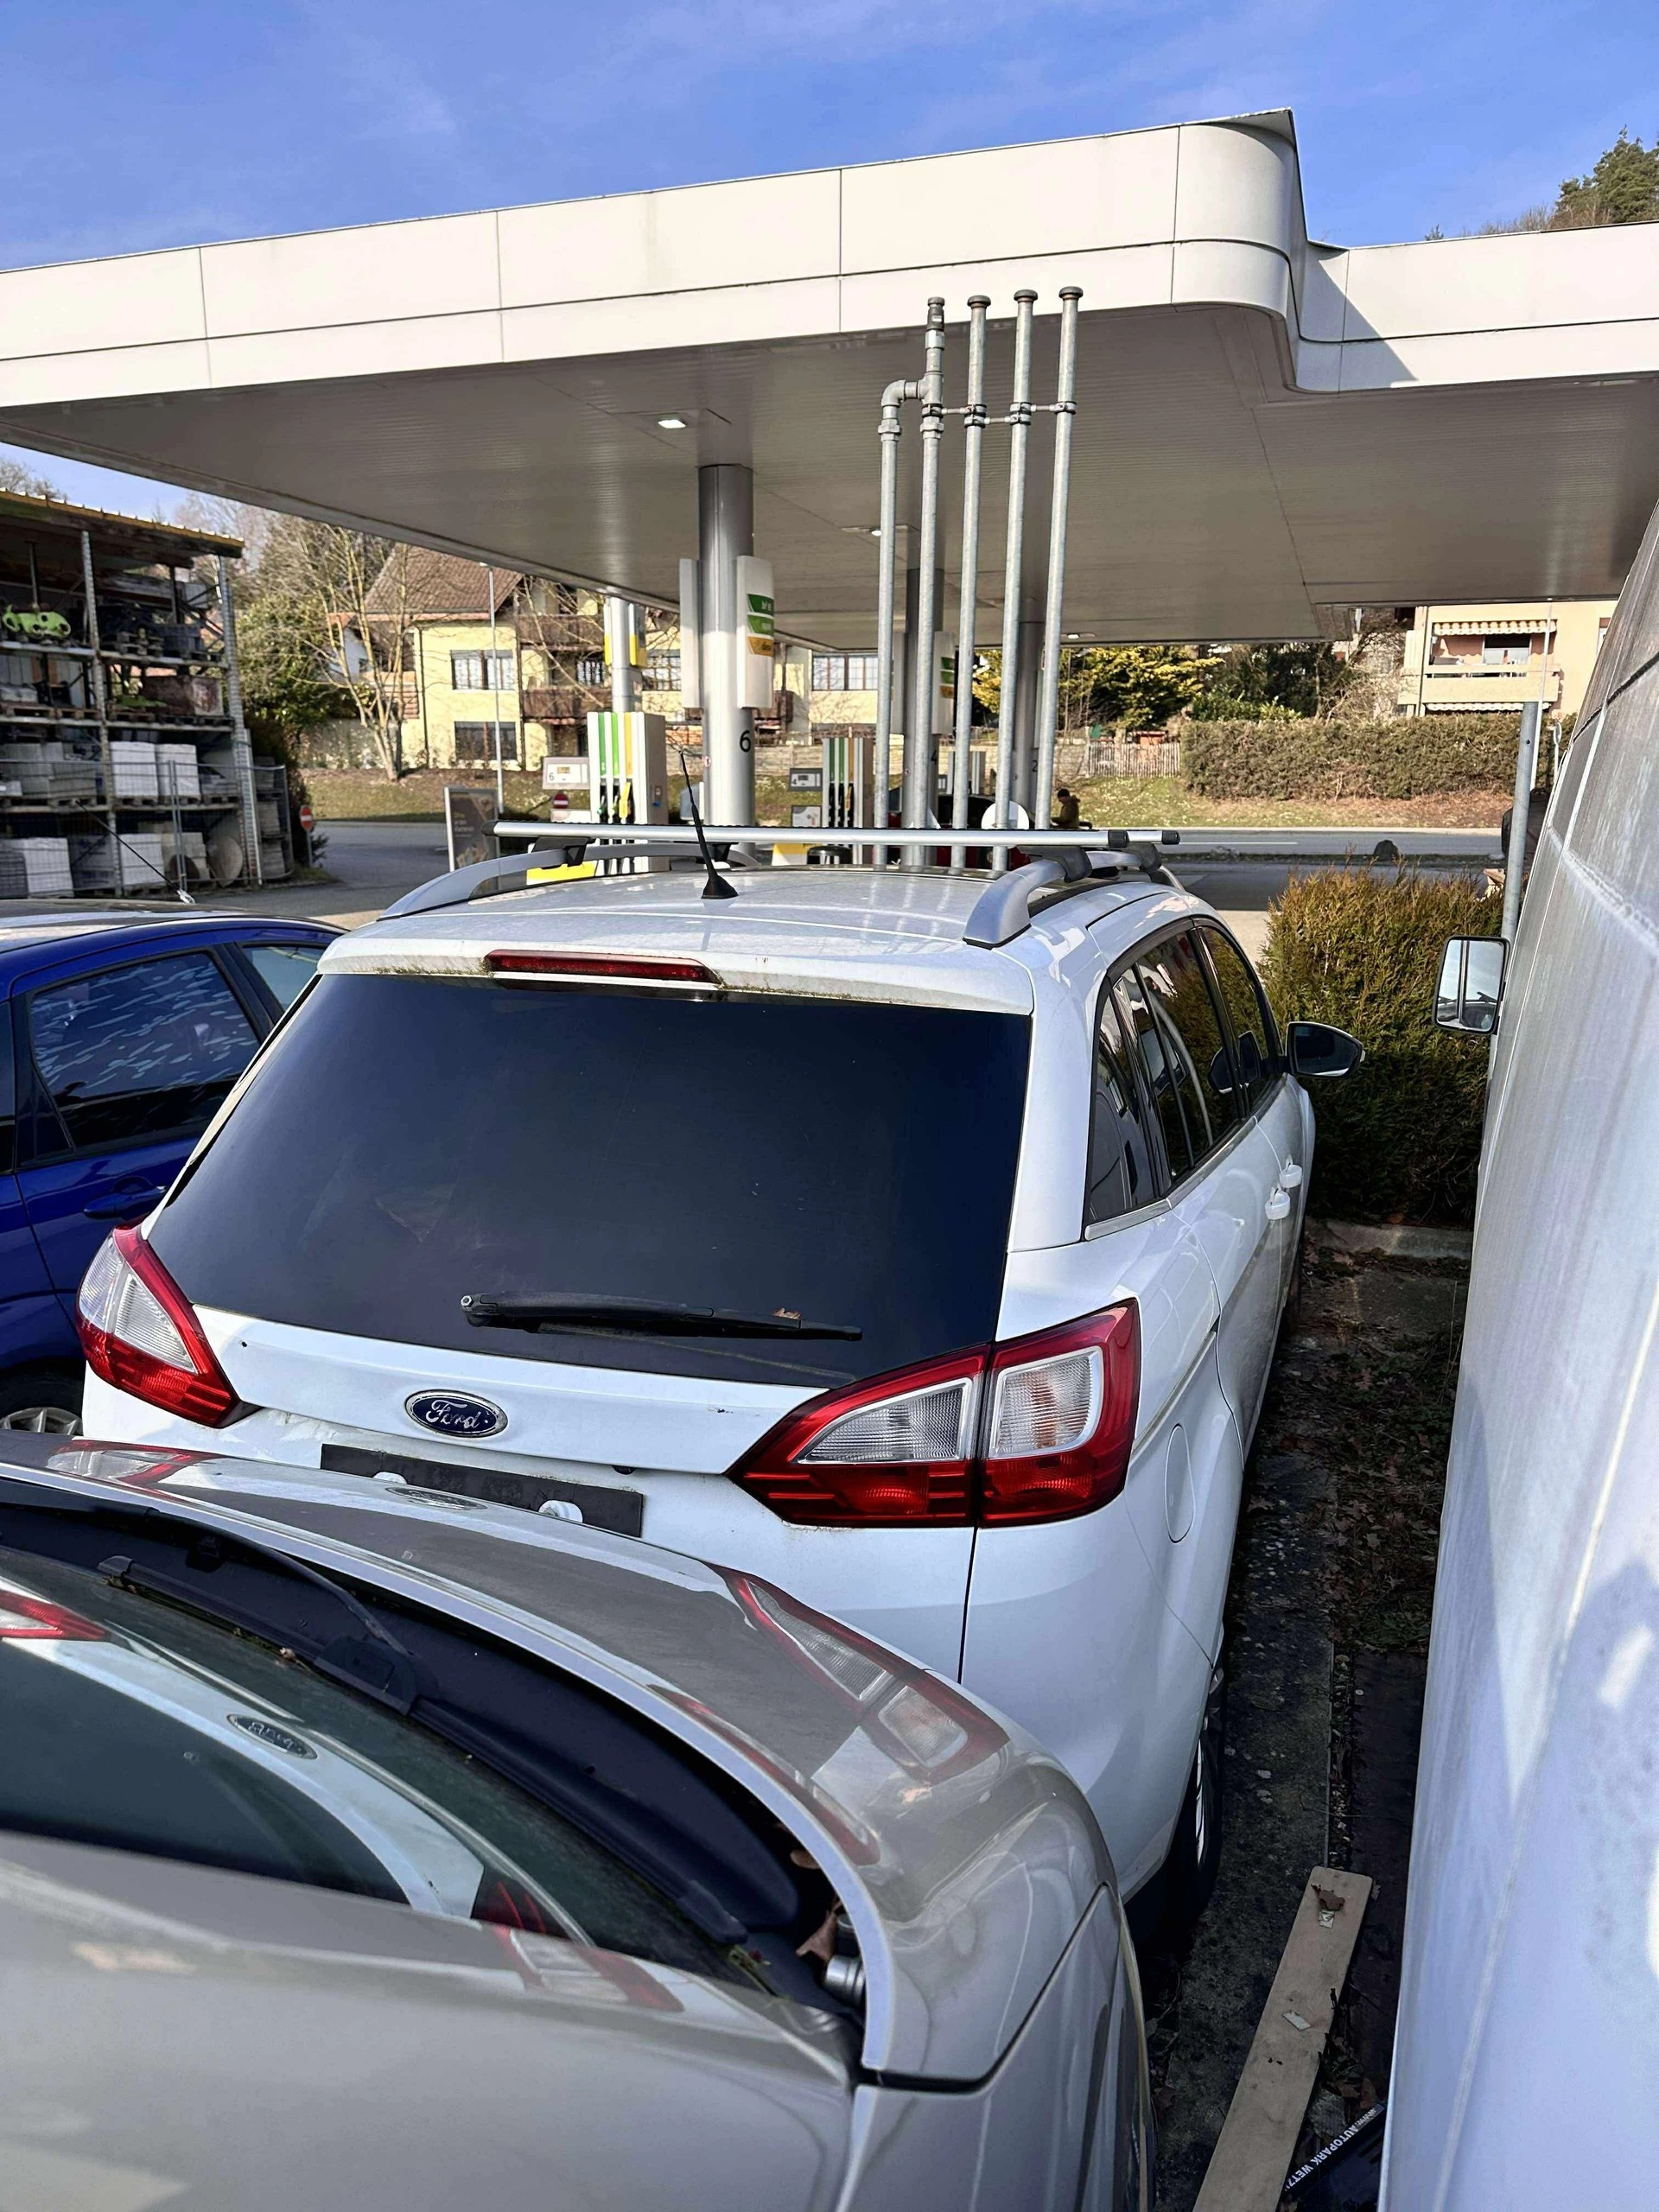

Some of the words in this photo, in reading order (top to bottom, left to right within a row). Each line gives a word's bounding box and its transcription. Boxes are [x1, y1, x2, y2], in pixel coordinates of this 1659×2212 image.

[740, 730, 751, 753] 6
[1033, 760, 1038, 772] 2
[550, 772, 555, 781] 6
[425, 1400, 481, 1429] Ford
